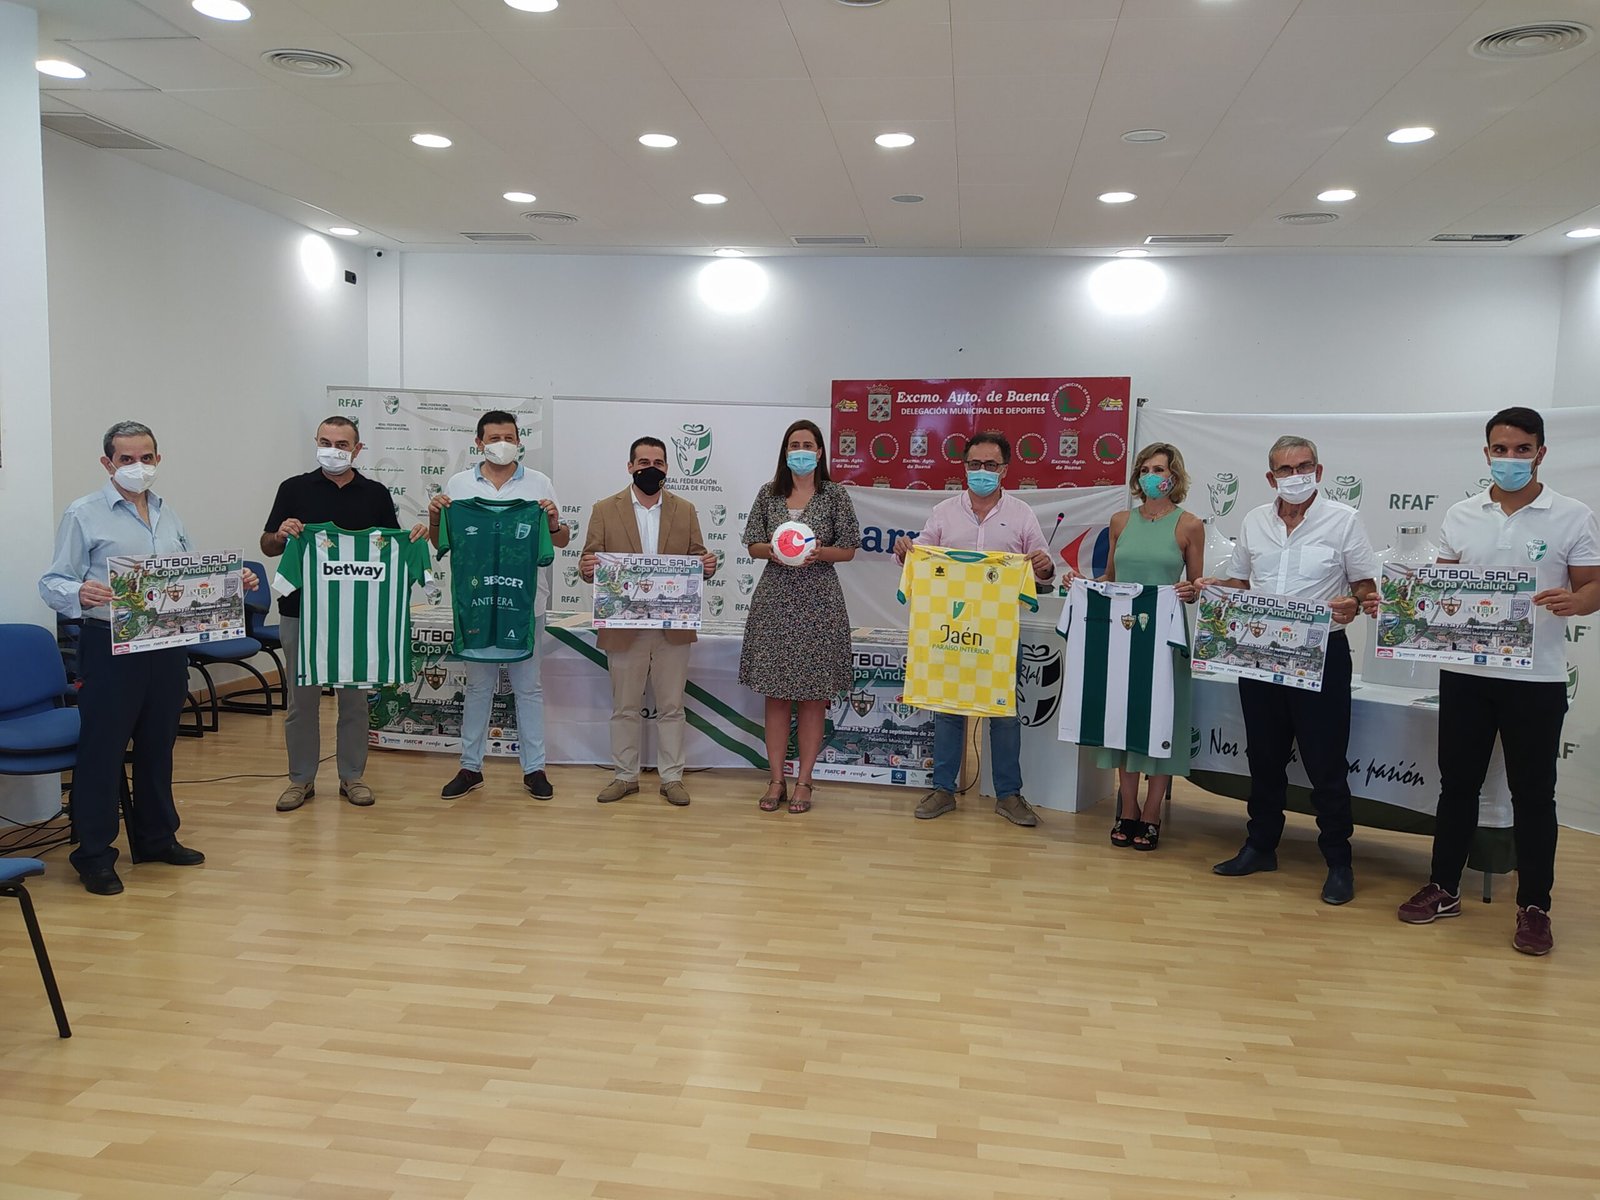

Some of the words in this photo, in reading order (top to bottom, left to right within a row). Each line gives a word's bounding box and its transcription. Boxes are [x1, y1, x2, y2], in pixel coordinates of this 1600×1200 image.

[338, 398, 364, 408] RFAF
[896, 391, 943, 403] Excmo.
[947, 390, 981, 405] Ayto.
[986, 390, 1002, 402] de
[1006, 390, 1050, 402] Baena
[901, 406, 948, 415] DELEGACIÓN
[949, 407, 992, 415] MUNICIPAL
[993, 407, 1004, 415] DE
[1005, 406, 1046, 415] DEPORTES
[420, 466, 445, 475] RFAF
[388, 487, 406, 496] FAF
[1388, 493, 1436, 511] RFAF
[562, 505, 581, 513] RFAF
[738, 513, 748, 521] RF
[707, 533, 728, 541] RFAF
[561, 549, 581, 558] RFAF
[145, 557, 198, 571] FUTBOL
[201, 553, 237, 565] SALA
[623, 557, 667, 566] FUTBOL
[669, 559, 698, 567] SALA
[736, 557, 755, 565] RFAF
[155, 566, 180, 577] Copa
[323, 562, 383, 580] betway
[631, 566, 651, 574] Copa
[1418, 568, 1480, 581] FUTBOL
[1484, 570, 1529, 582] SALA
[706, 579, 727, 587] RFAF
[1429, 579, 1457, 590] Copa
[1460, 580, 1516, 591] Andalucía
[471, 596, 514, 608] ANTEERA
[561, 595, 581, 604] RFAF
[1232, 593, 1284, 609] FUTBOL
[1287, 601, 1325, 615] SALA
[735, 603, 750, 612] RFA
[1240, 602, 1266, 615] Copa
[411, 629, 454, 643] UTBO
[940, 624, 982, 646] Jaén
[411, 643, 441, 655] Copa
[932, 643, 958, 652] PARAÍSO
[959, 646, 990, 655] INTERIOR
[851, 653, 897, 668] TBOL
[854, 669, 869, 682] pa
[1209, 727, 1239, 757] Nos
[1365, 757, 1425, 787] pasión
